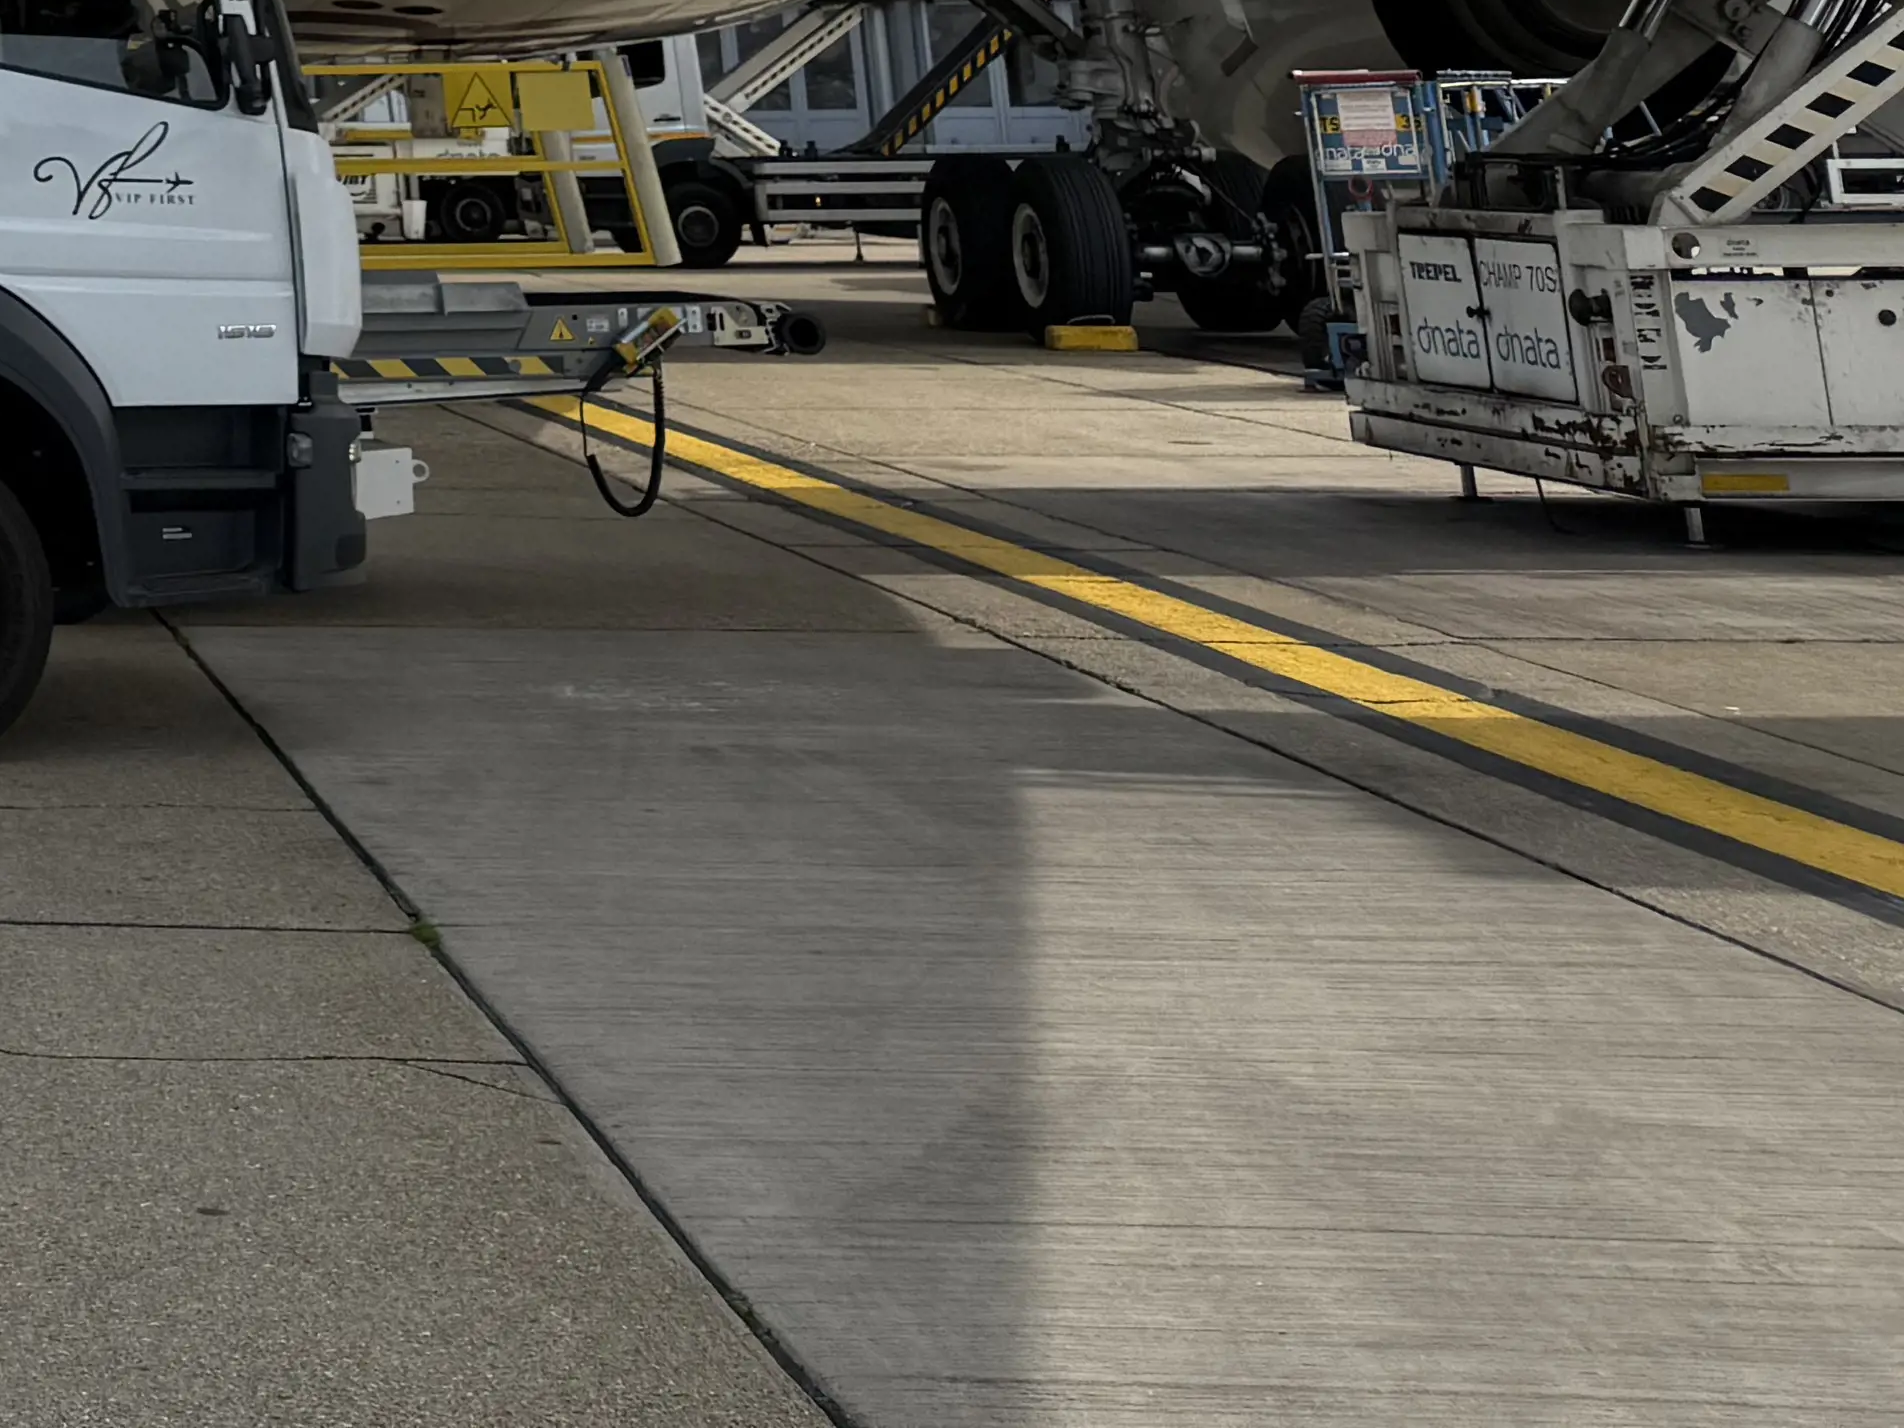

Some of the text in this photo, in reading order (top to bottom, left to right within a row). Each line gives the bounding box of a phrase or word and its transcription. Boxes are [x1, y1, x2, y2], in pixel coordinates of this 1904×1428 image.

[114, 192, 197, 206] VIP FIRST
[1409, 260, 1463, 284] TREPEL
[1478, 259, 1522, 290] CHAMP
[1416, 315, 1562, 370] dnata dnata
